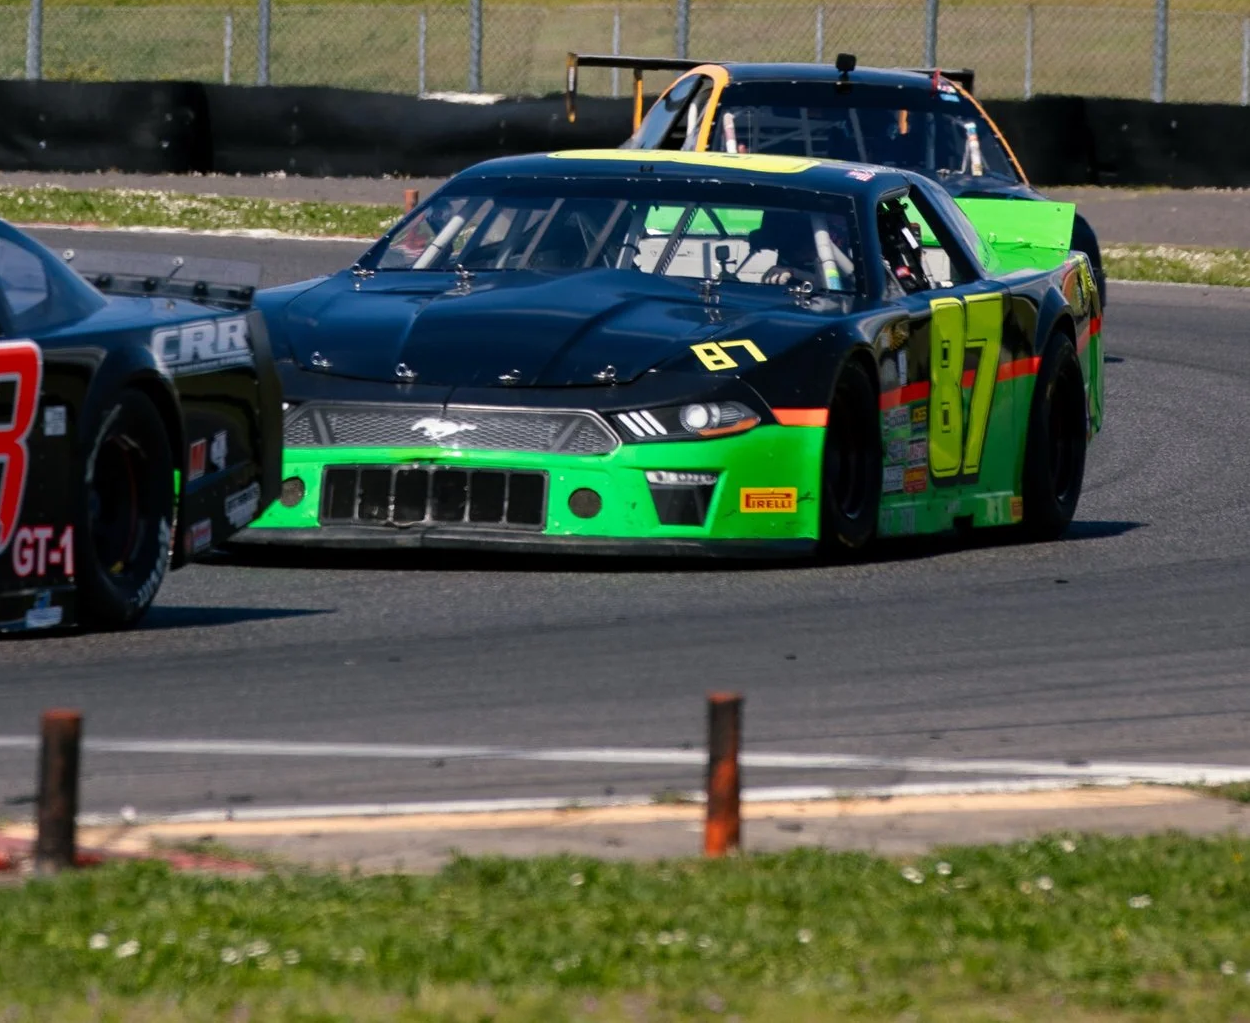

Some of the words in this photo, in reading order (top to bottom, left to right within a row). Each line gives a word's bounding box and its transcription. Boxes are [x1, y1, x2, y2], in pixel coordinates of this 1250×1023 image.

[152, 317, 249, 367] CRR
[690, 339, 768, 371] 87
[930, 293, 1003, 478] 87
[745, 493, 793, 509] PIRELLI
[12, 526, 75, 577] GT-1
